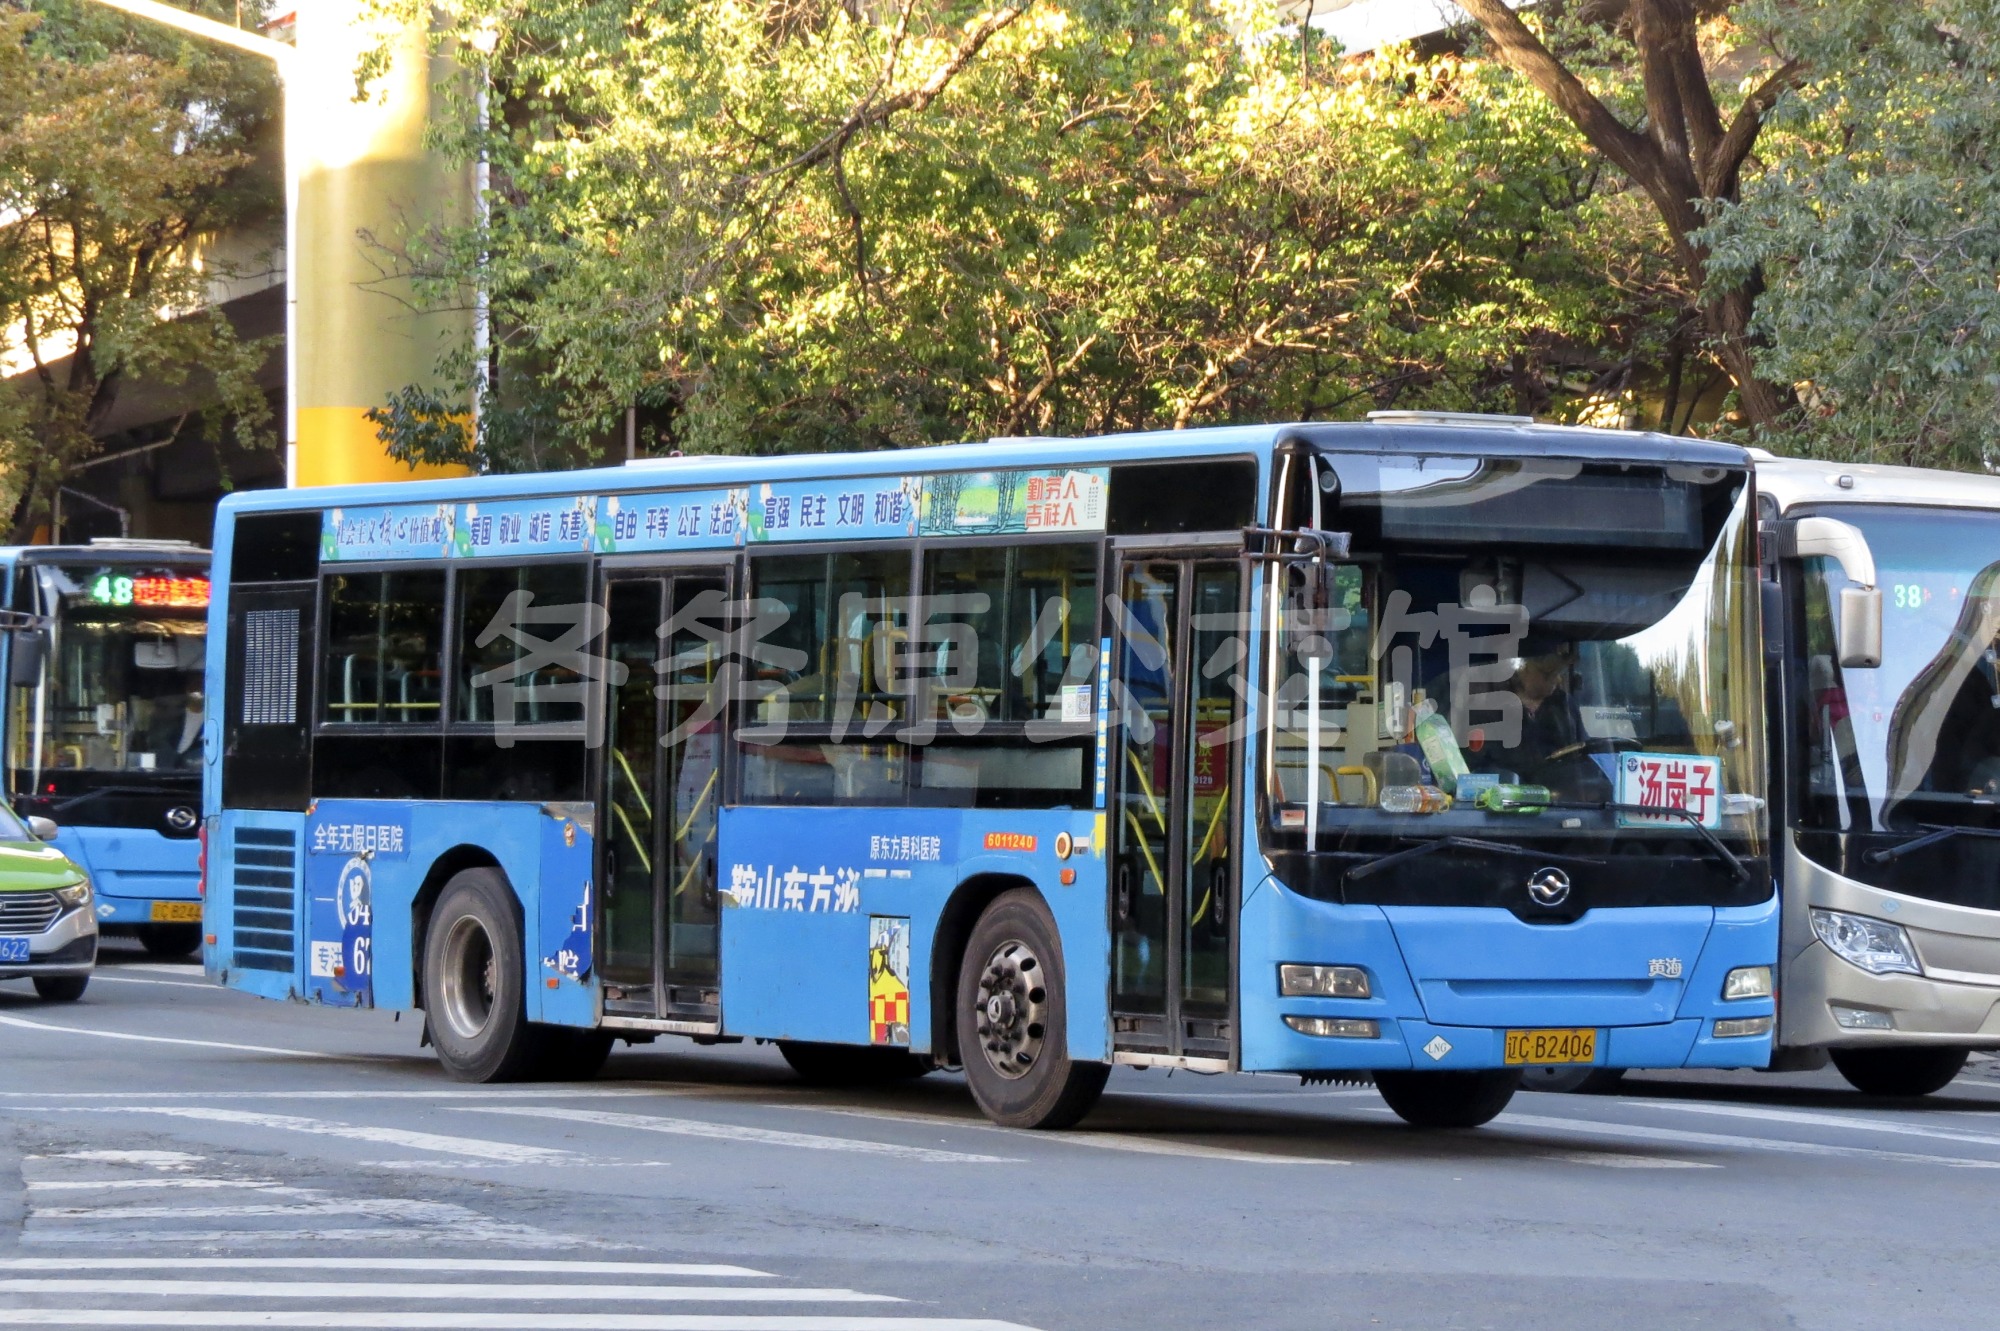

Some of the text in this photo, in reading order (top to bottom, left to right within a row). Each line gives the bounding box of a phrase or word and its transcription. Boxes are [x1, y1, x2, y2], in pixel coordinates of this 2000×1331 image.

[1027, 476, 1079, 501] 勤劳人
[614, 502, 734, 540] 自由 平等 公正 法治
[764, 491, 902, 529] 富强 民主 文明 和谐
[1025, 502, 1077, 527] 吉祥人
[336, 510, 441, 545] 社会主义核心价值观
[470, 509, 583, 546] 爱国 敬业 诚信 友善
[93, 576, 133, 604] 48
[1894, 584, 1922, 608] 38
[1638, 760, 1715, 821] 汤岗子
[314, 823, 404, 853] 全年无假日医院
[869, 835, 941, 862] 原东方男科医院
[987, 833, 1034, 850] 6011240
[0, 941, 28, 958] 622
[1648, 957, 1683, 978] 黄海
[1428, 1043, 1447, 1054] LNG
